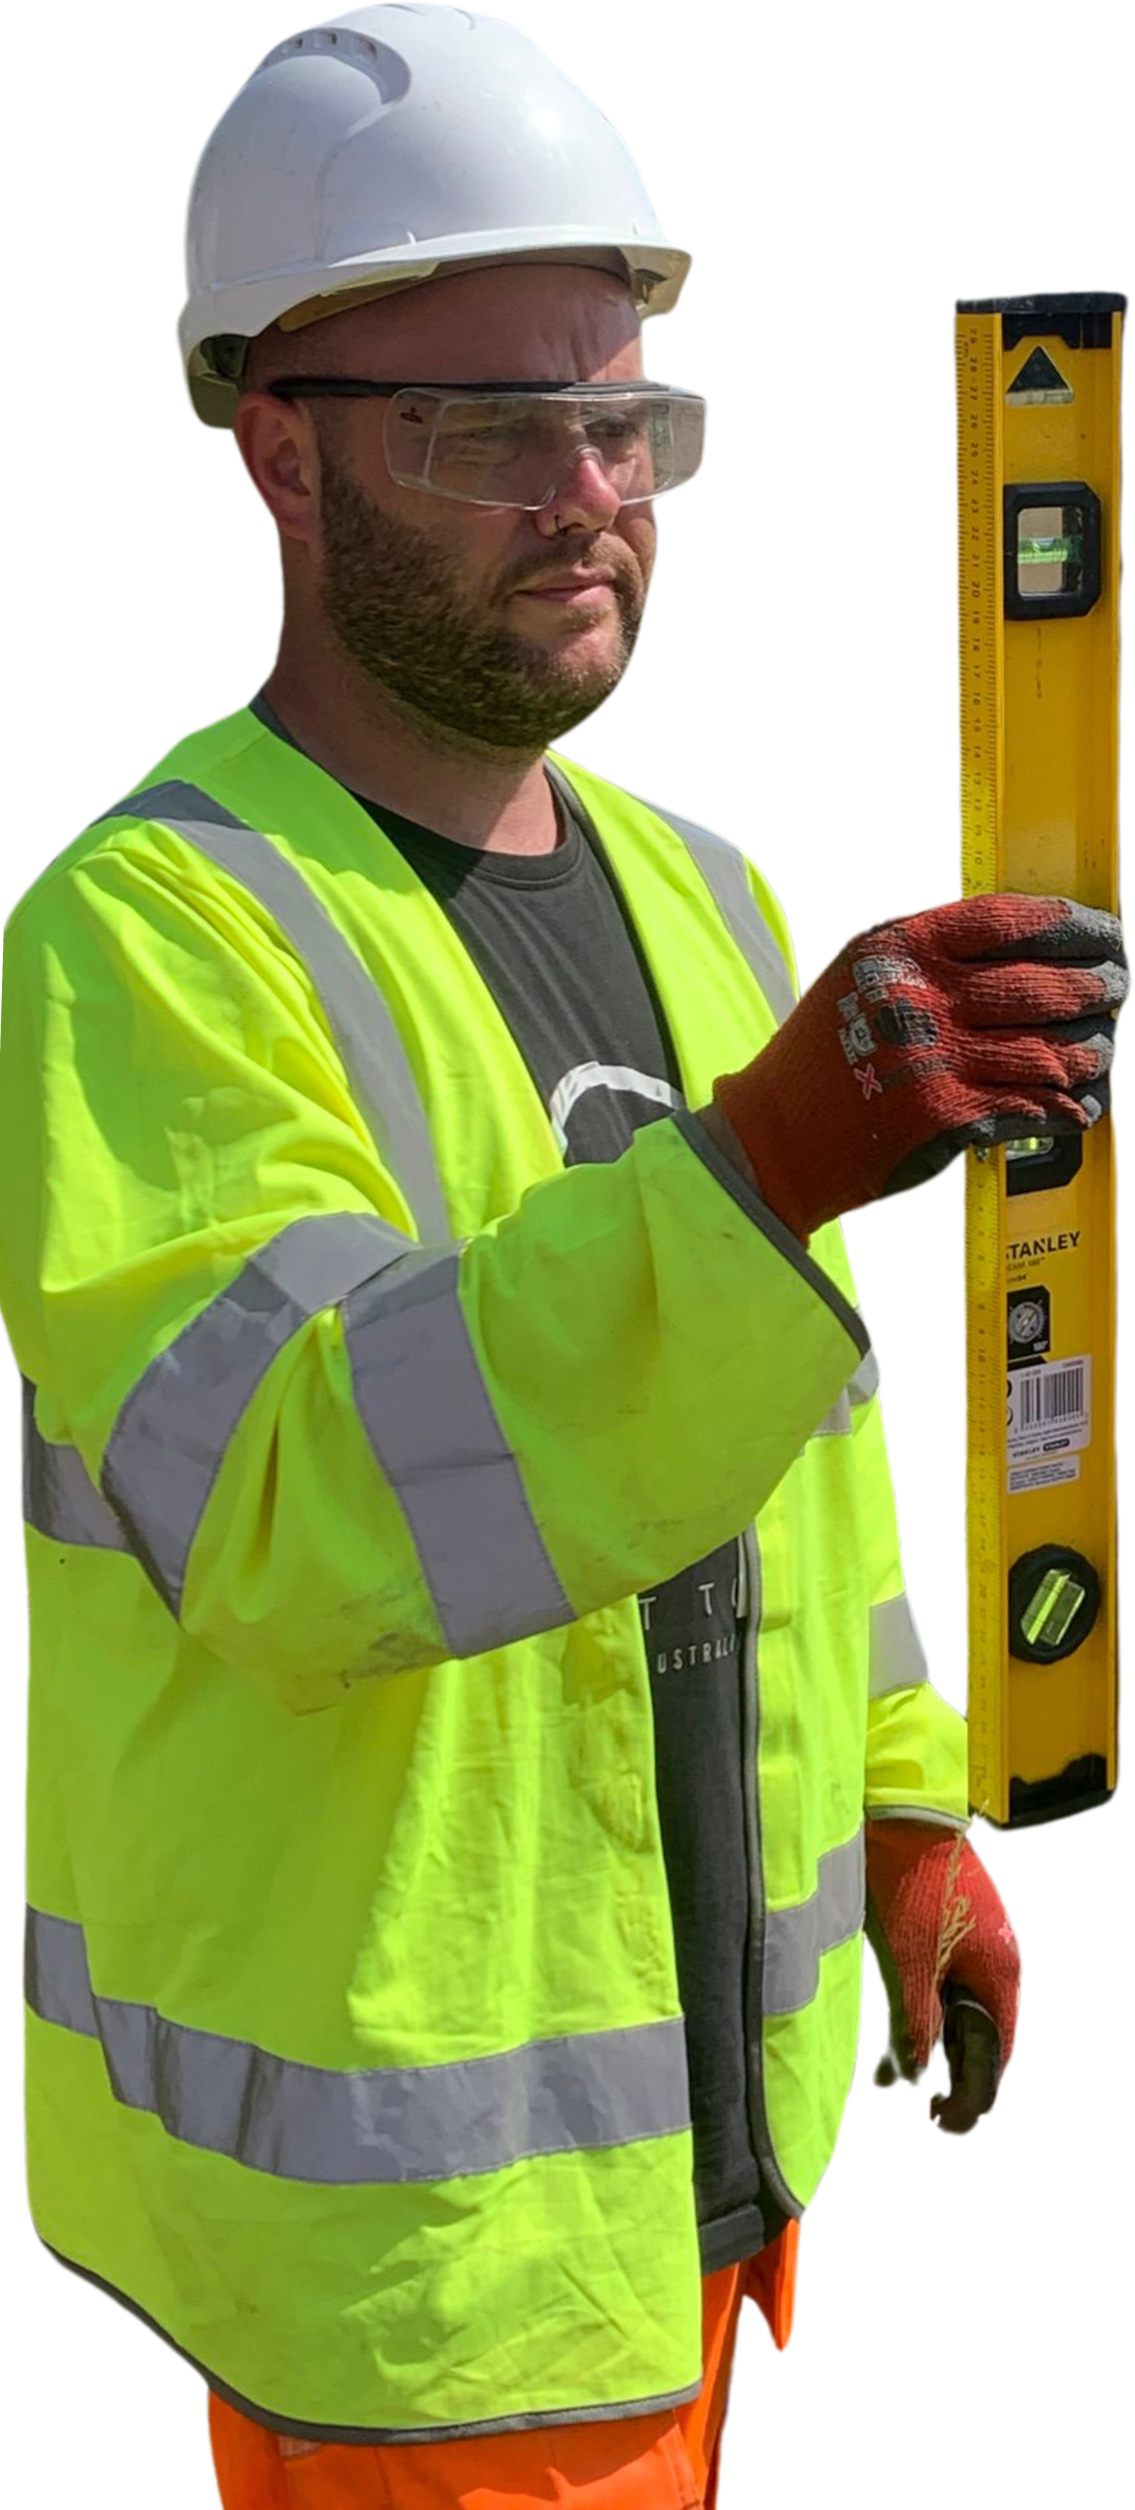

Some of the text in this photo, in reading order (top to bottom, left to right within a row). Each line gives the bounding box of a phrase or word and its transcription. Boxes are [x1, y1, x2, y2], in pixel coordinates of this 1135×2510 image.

[970, 357, 977, 372] 28
[970, 386, 977, 400] 27
[971, 414, 978, 429] 26
[971, 442, 978, 457] 25
[971, 470, 978, 485] 24
[972, 499, 979, 513] 23
[972, 526, 979, 541] 22
[972, 554, 979, 567] 21
[972, 581, 980, 598] 20
[973, 611, 980, 624] 19
[973, 665, 980, 678] 17
[973, 692, 980, 705] 16
[974, 745, 982, 758] 14
[975, 851, 982, 865] 10
[1006, 1231, 1080, 1260] TANLEY
